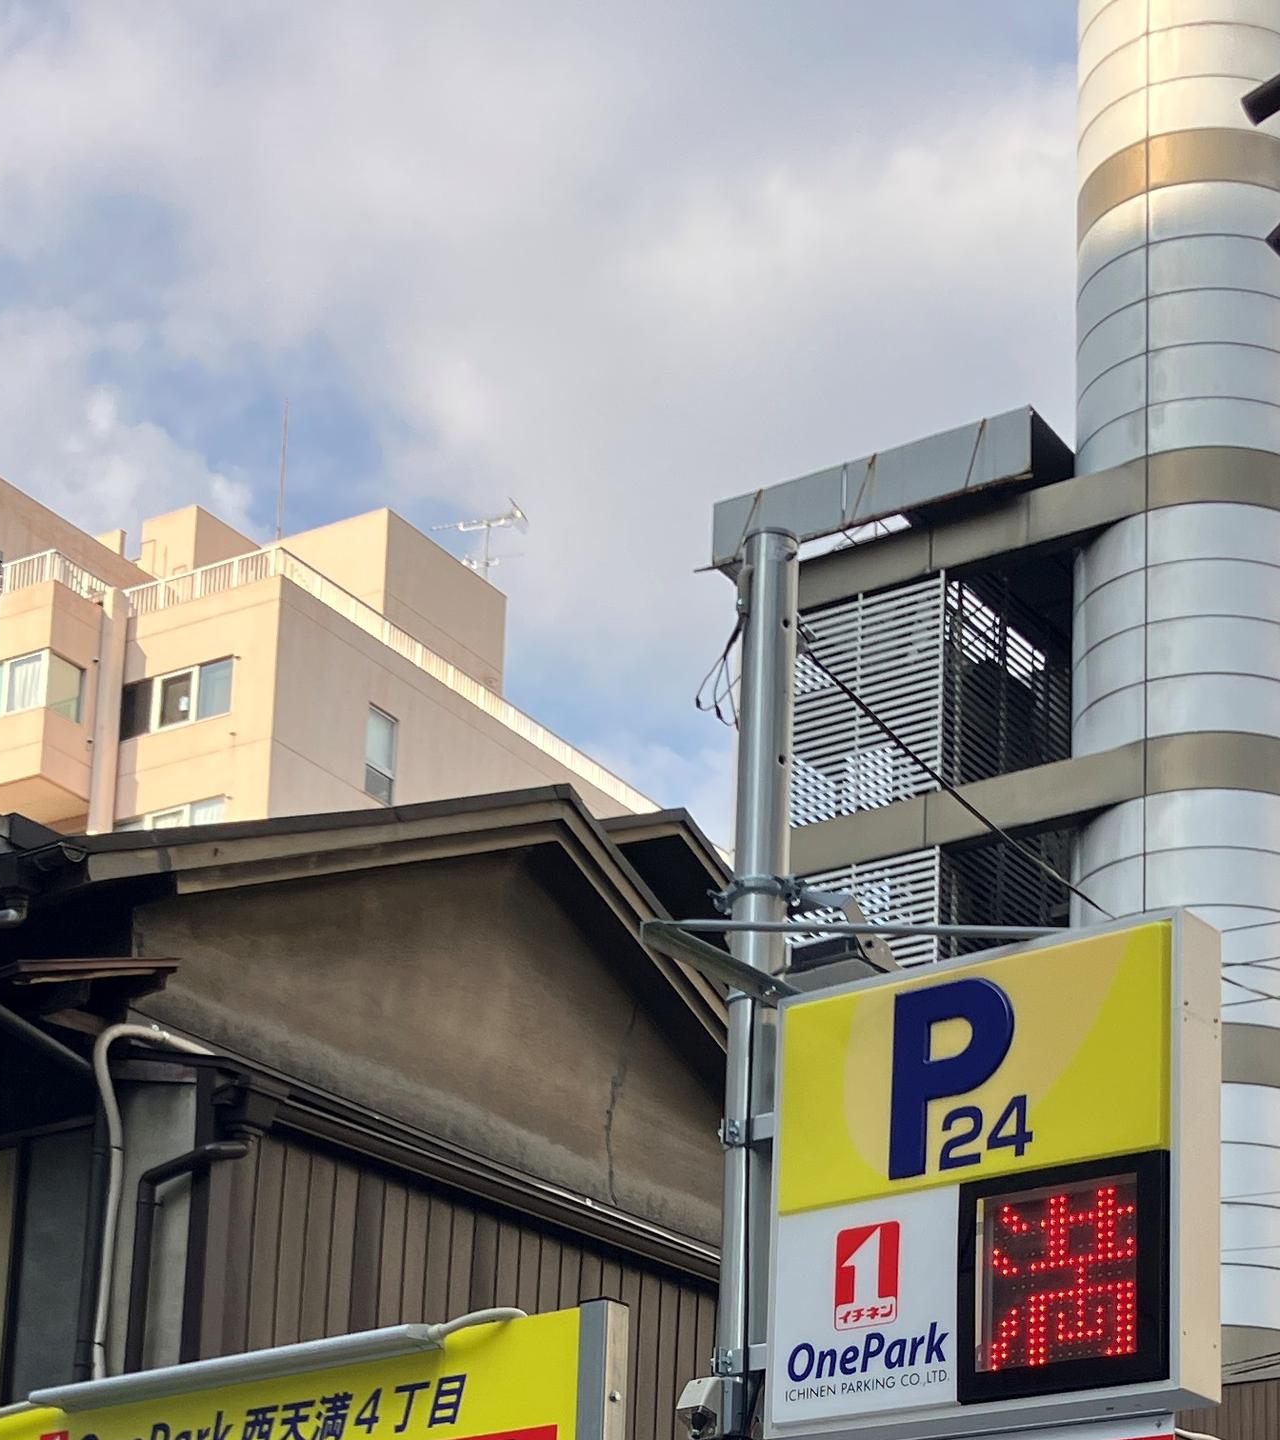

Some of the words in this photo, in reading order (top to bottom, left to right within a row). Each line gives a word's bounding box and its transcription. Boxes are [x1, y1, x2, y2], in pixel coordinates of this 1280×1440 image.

[888, 976, 1015, 1180] P
[938, 1095, 1033, 1171] 24
[992, 1186, 1137, 1372] 満
[839, 1303, 893, 1324] イチネン
[787, 1321, 950, 1382] OnePark
[785, 1383, 837, 1402] ICHINEN
[841, 1375, 896, 1395] PARKING
